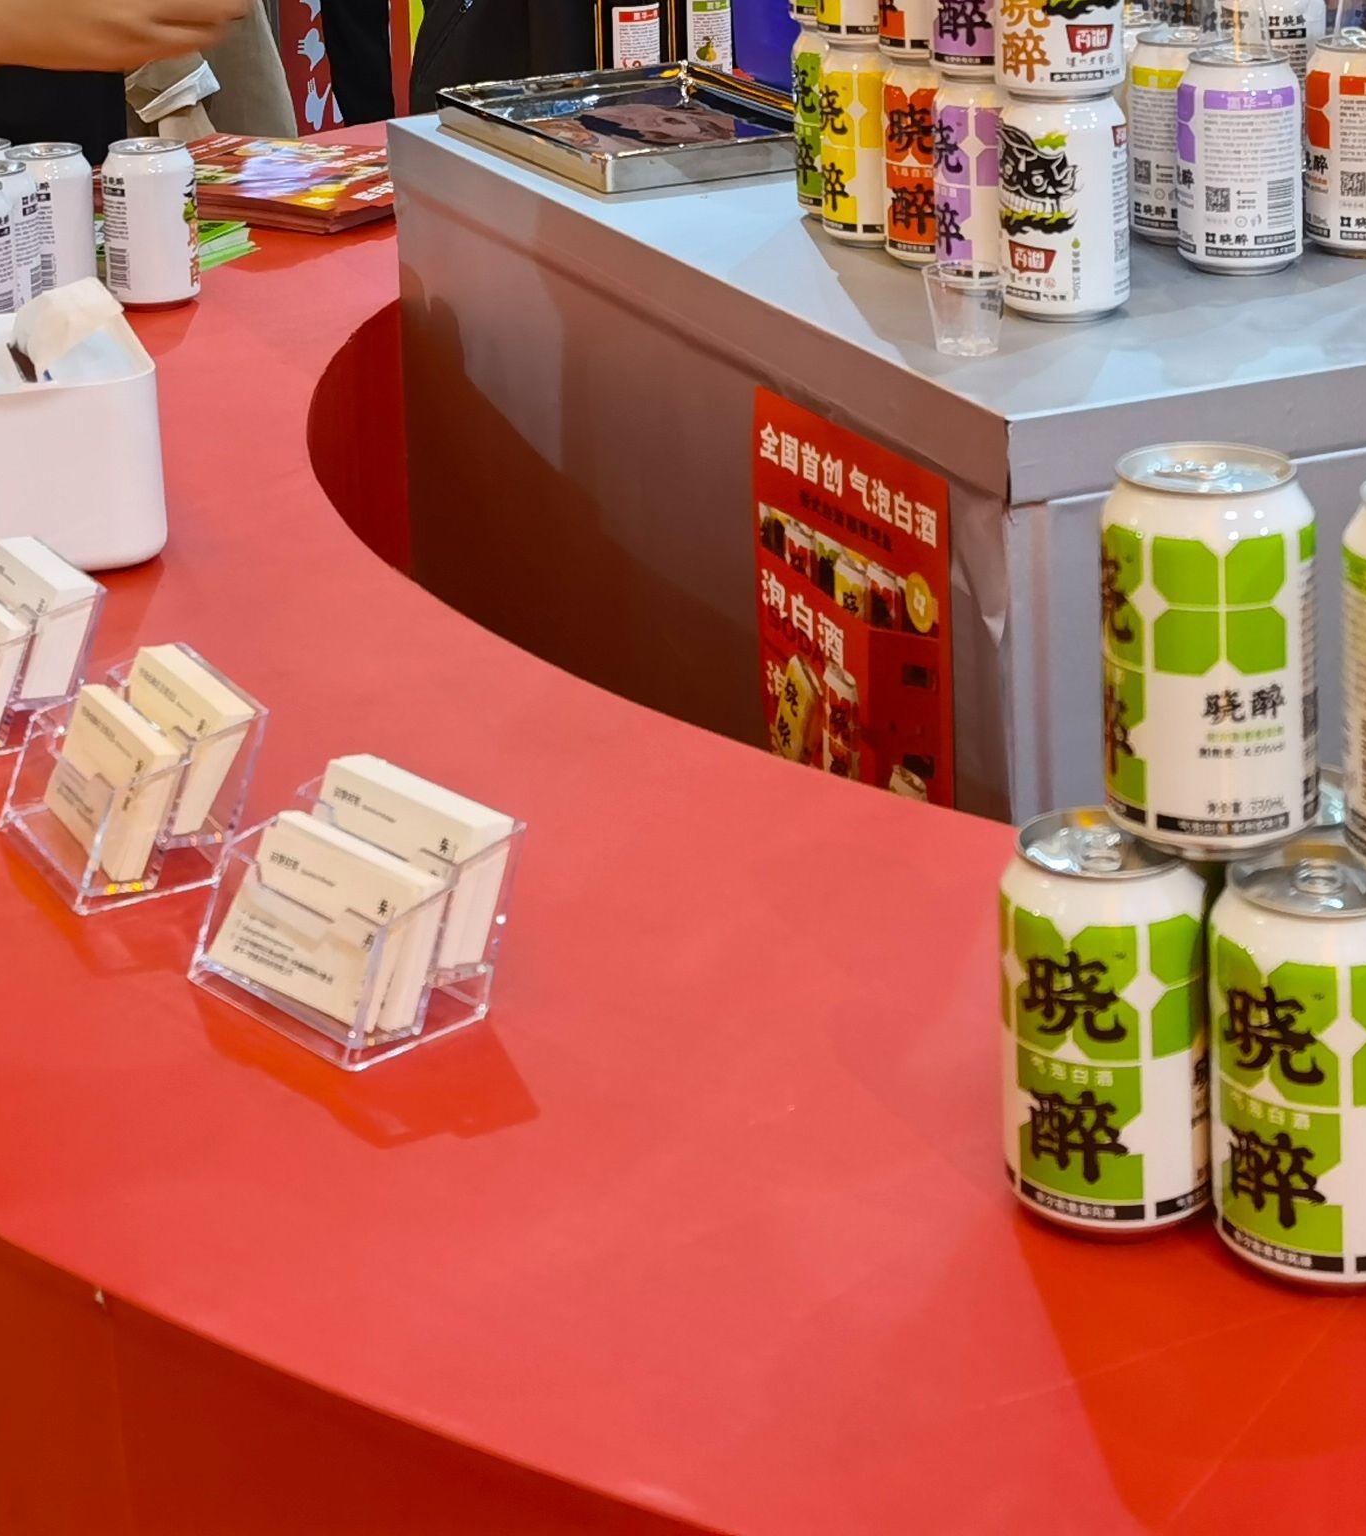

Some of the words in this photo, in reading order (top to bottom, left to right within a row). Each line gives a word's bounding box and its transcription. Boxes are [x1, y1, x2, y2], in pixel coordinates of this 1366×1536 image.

[759, 421, 843, 498] 全国首创
[849, 464, 938, 549] 气泡白酒
[1202, 683, 1286, 725] 晓醉
[1023, 952, 1130, 1184] 晓醉
[1222, 986, 1327, 1229] 晓醉
